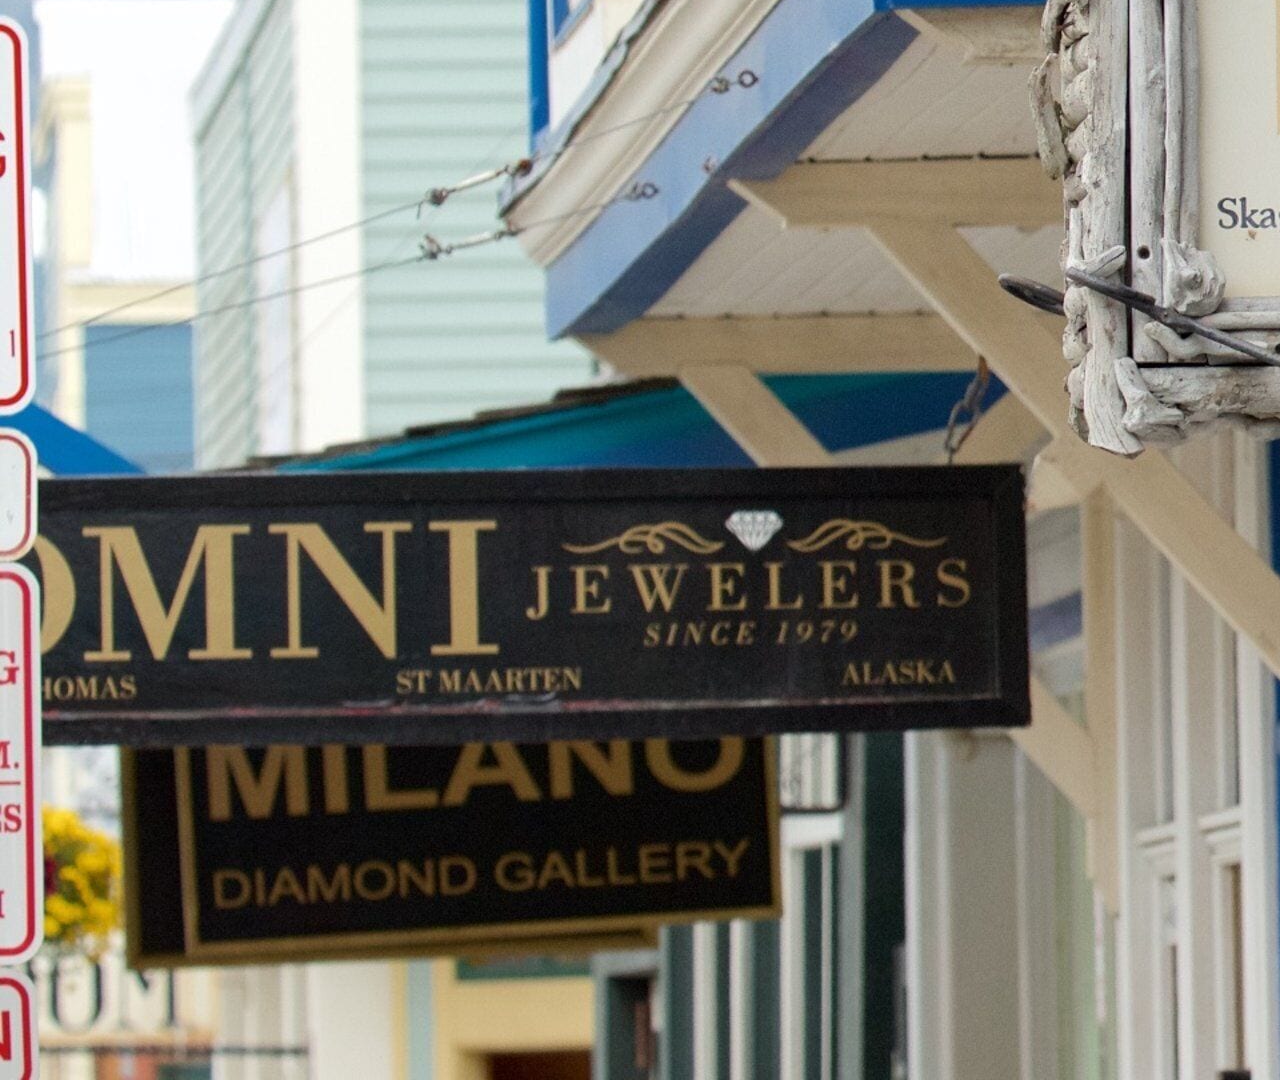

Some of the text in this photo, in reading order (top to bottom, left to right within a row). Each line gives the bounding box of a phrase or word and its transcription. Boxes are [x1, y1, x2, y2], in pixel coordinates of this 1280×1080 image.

[525, 558, 973, 621] JEWELERS
[643, 620, 860, 647] SINCE 1979
[395, 667, 583, 694] ST MAARTEN
[842, 660, 956, 686] ALASKA
[211, 838, 751, 909] DIAMOND GALLERY
